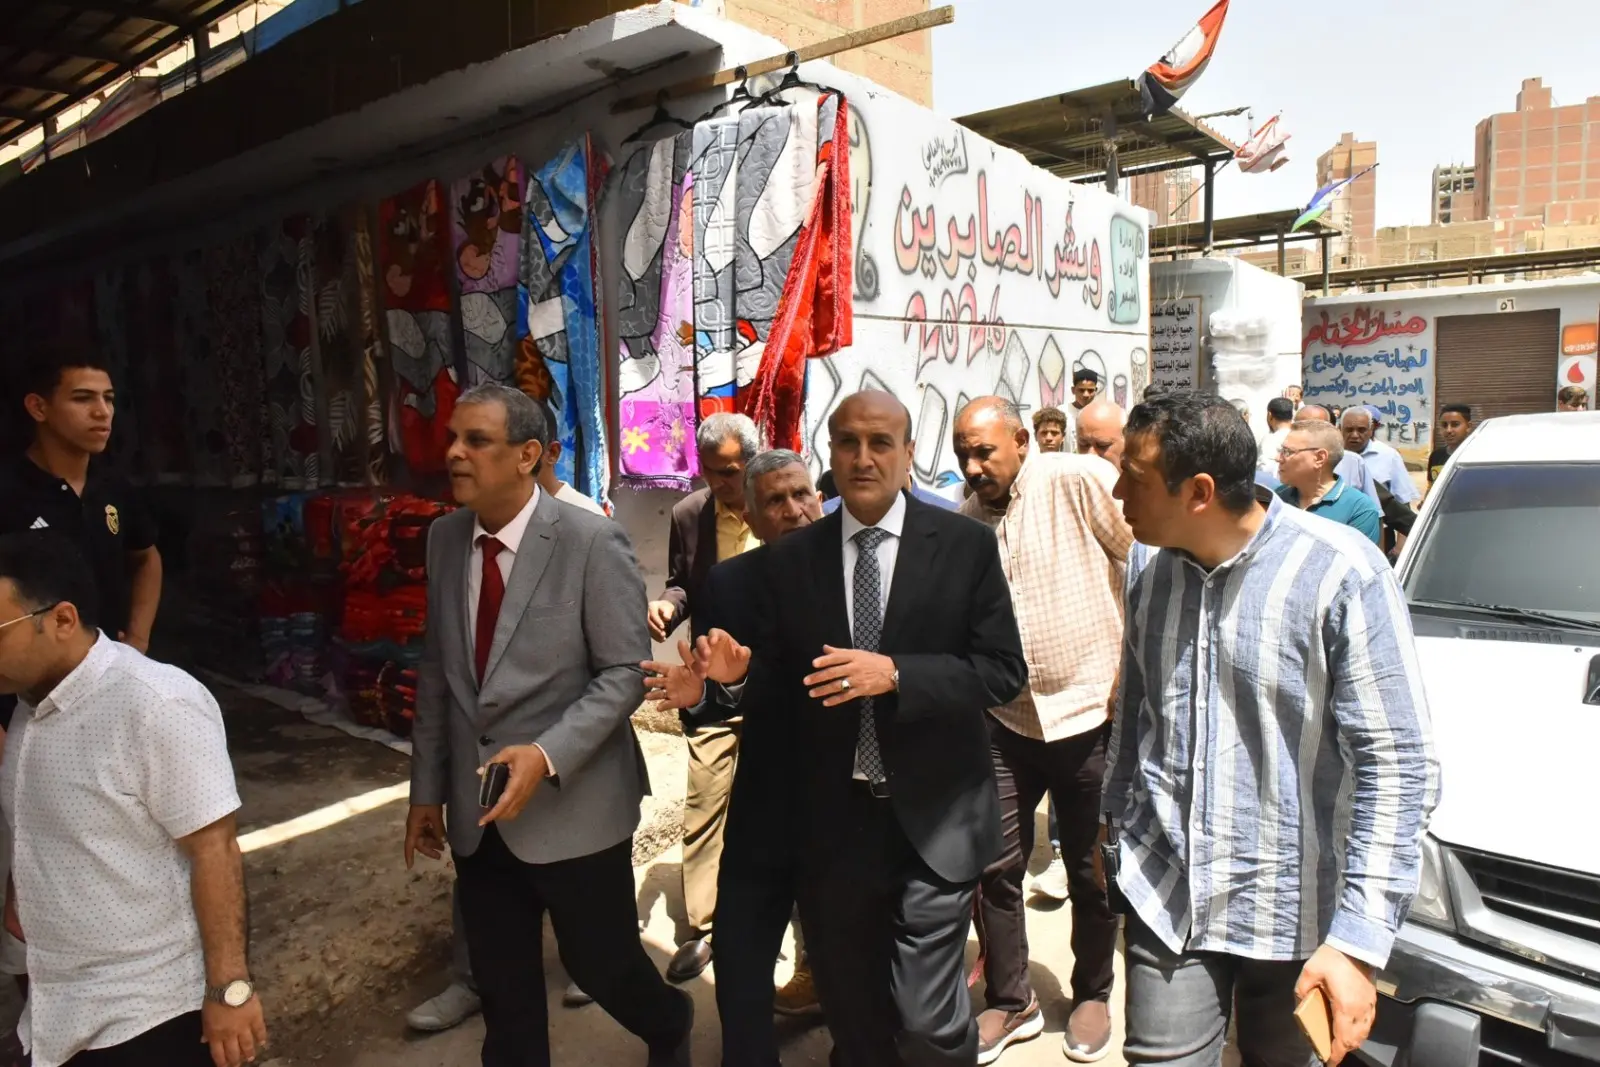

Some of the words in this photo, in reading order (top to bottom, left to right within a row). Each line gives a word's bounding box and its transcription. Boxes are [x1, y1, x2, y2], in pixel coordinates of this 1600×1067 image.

[894, 169, 1042, 281] الصابرين
[1045, 207, 1101, 310] وبشر
[1500, 299, 1515, 311] ٥٦
[1373, 348, 1427, 372] لصيانة
